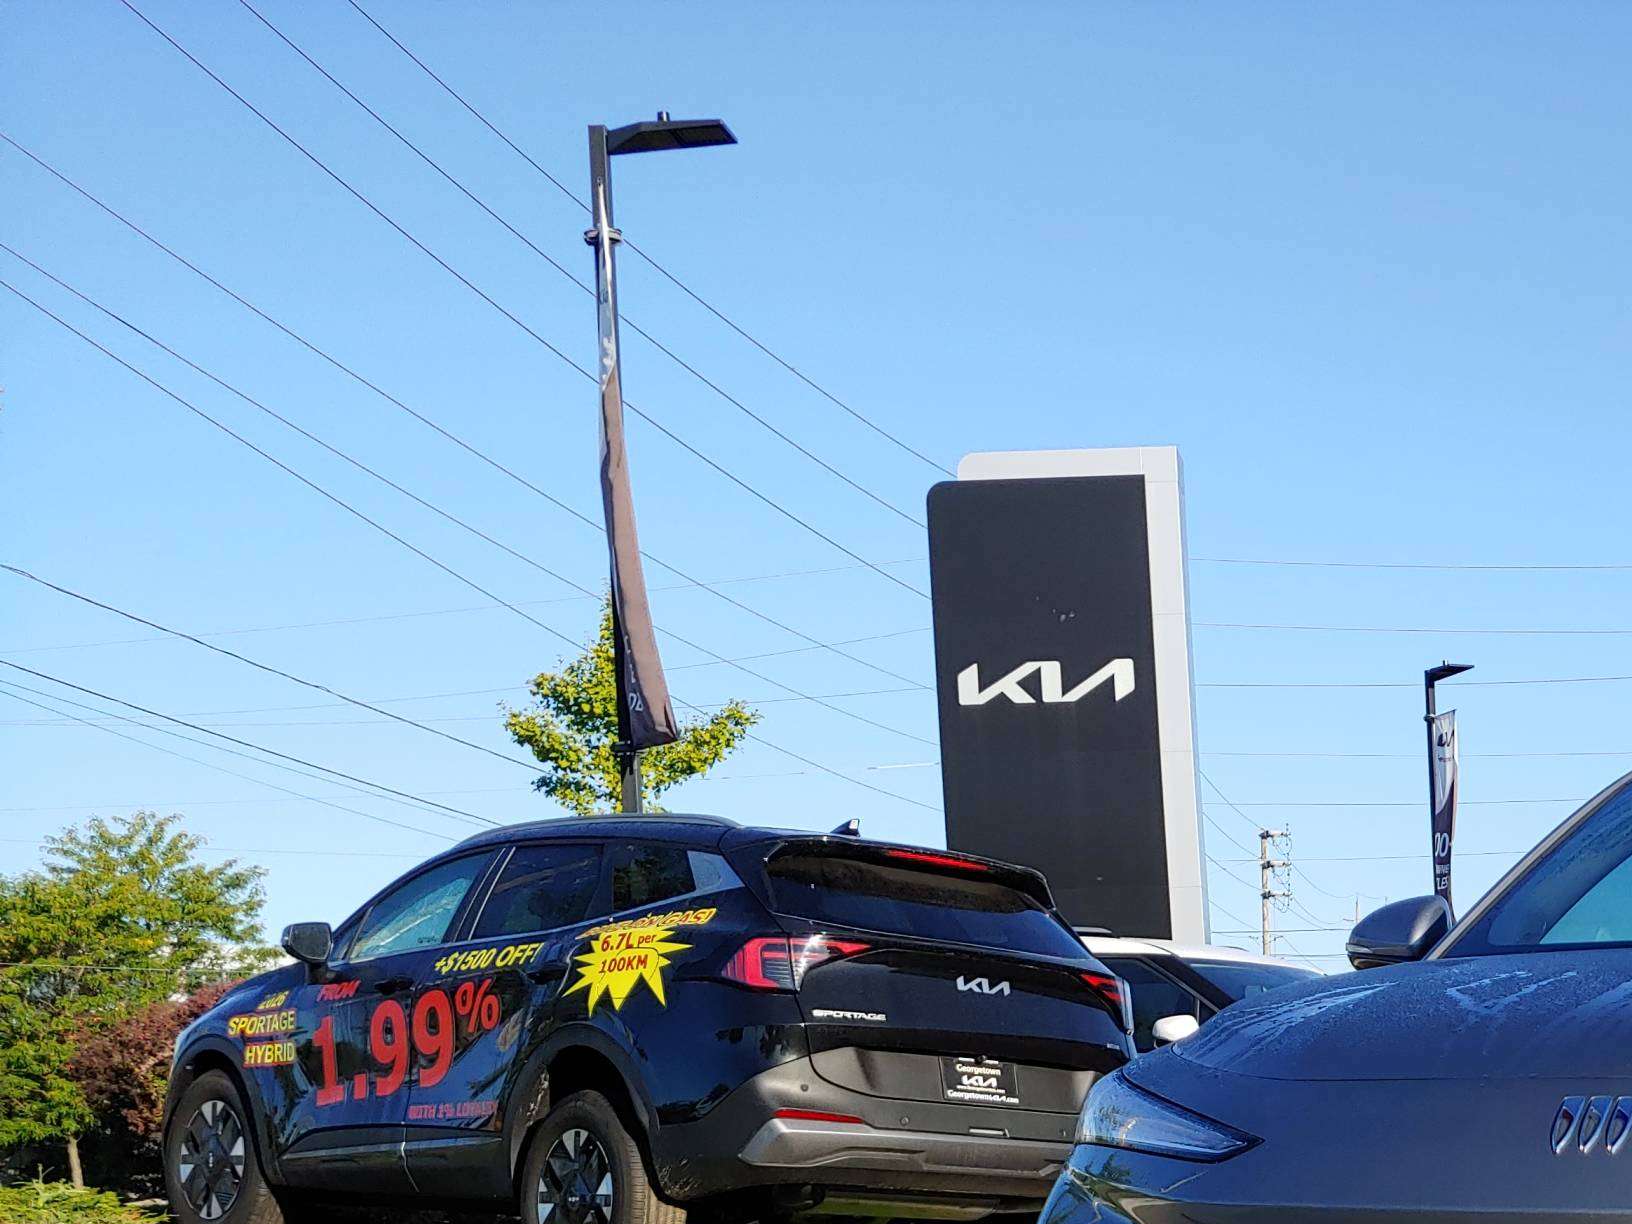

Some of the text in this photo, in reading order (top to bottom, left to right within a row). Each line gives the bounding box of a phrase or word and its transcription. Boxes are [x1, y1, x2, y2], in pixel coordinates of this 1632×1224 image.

[957, 658, 1136, 706] KIA
[601, 932, 657, 952] 6.7L per
[435, 942, 545, 975] +$1500 OFF!
[599, 954, 649, 974] 100KM
[956, 975, 1011, 996] KIA
[227, 1010, 297, 1036] SPORTAGE
[812, 1008, 887, 1022] SPORTAGE
[312, 978, 501, 1107] 1.99%
[244, 1041, 297, 1066] HYBRID
[956, 1063, 1002, 1077] Georgetown
[961, 1074, 998, 1089] KIA
